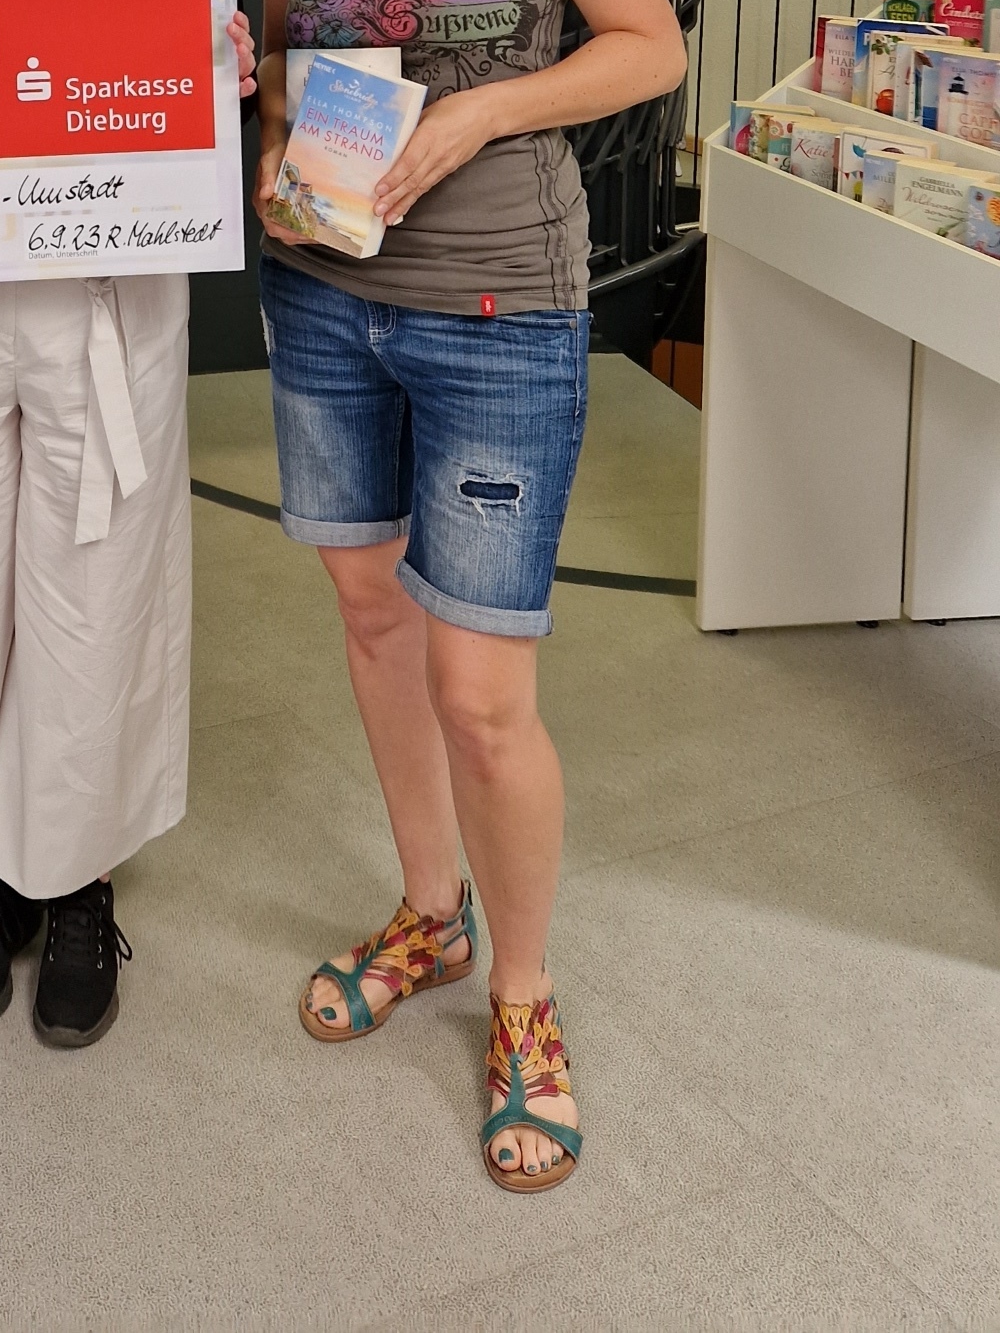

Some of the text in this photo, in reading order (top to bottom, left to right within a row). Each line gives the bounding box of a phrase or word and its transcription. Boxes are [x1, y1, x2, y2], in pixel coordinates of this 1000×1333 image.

[65, 74, 193, 104] Sparkasse
[66, 108, 167, 134] Dieburg
[306, 95, 393, 133] ELLA THOMPSON
[306, 107, 384, 147] EIN TRAUM
[298, 122, 384, 161] AM STRAND
[324, 146, 348, 158] ROMAN
[794, 138, 829, 160] Katie
[912, 180, 963, 197] ENGELMANN
[919, 176, 956, 189] GABRIELLA
[28, 223, 101, 252] 6.9.23
[28, 249, 98, 260] Datum, Unterschrift
